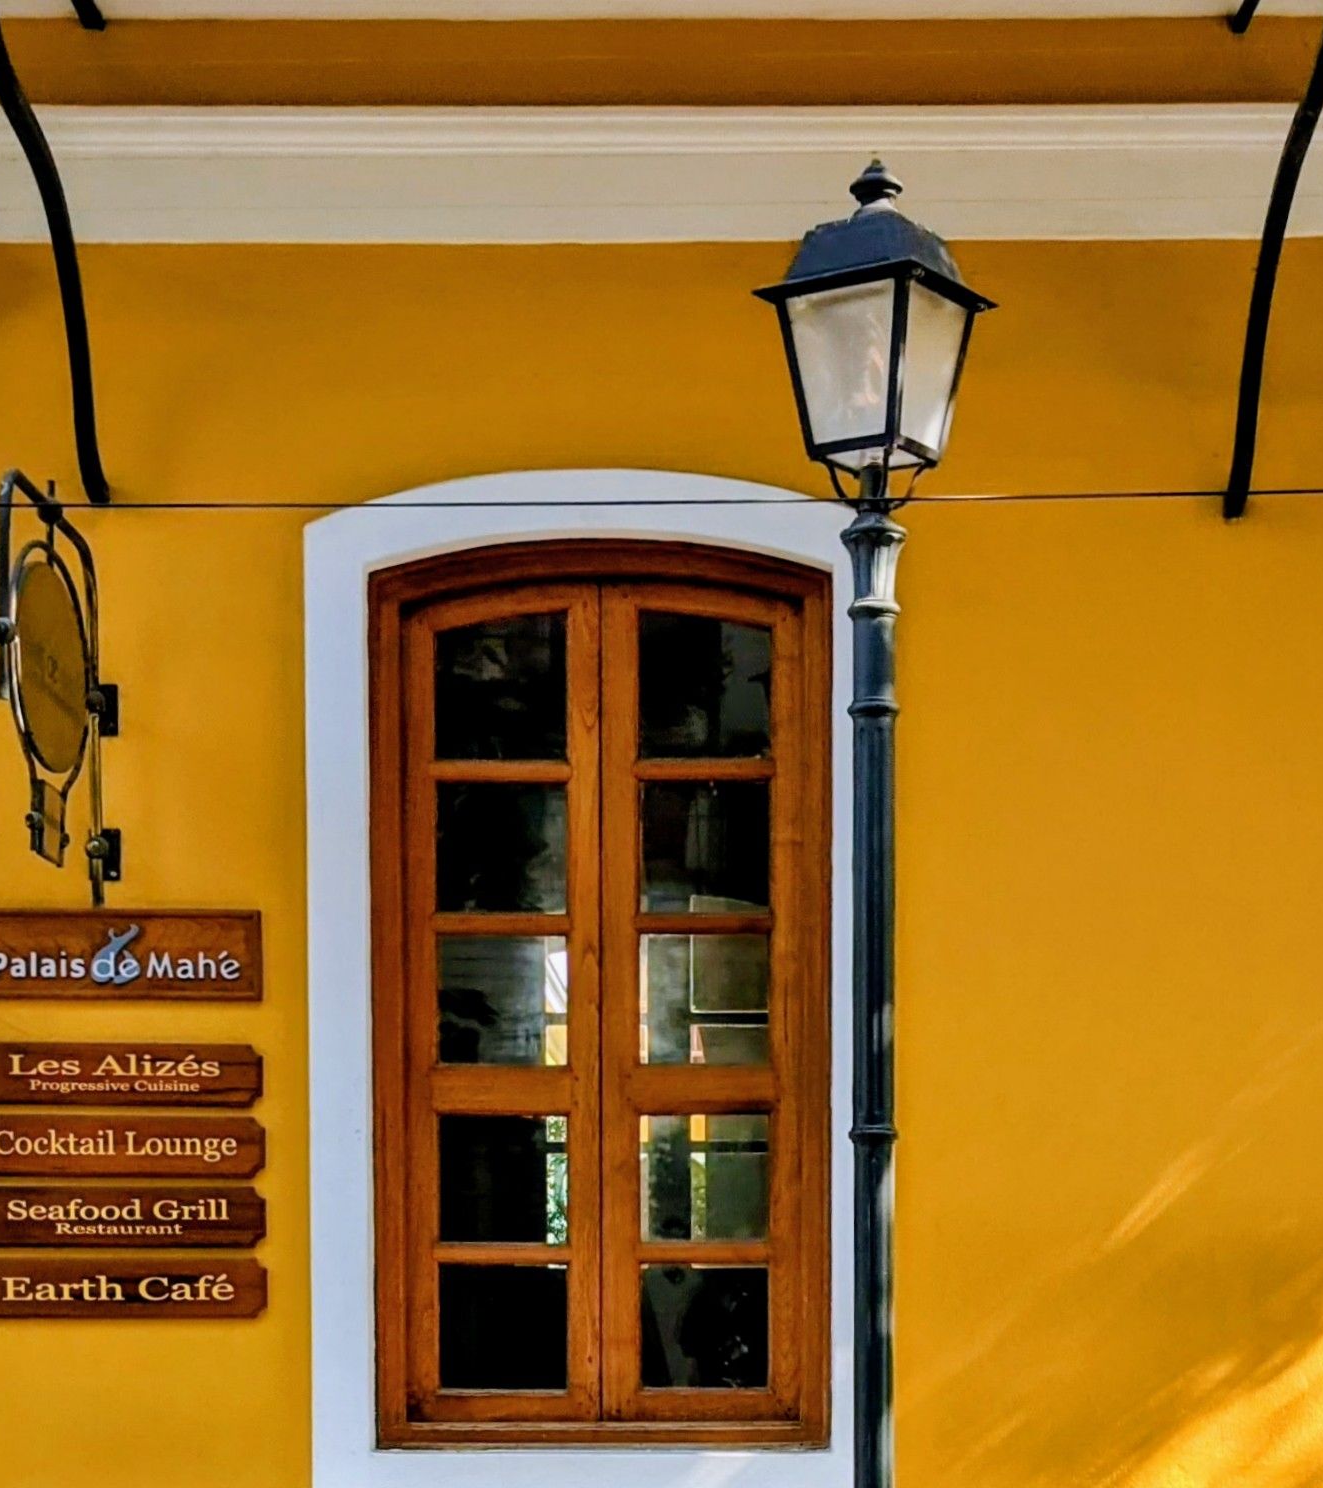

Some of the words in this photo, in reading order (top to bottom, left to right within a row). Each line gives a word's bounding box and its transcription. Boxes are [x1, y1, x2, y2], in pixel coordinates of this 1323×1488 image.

[91, 951, 140, 979] de
[146, 950, 241, 980] Mahé
[8, 1054, 80, 1076] Les
[92, 1053, 221, 1077] Alizés
[29, 1079, 131, 1093] Progressive
[134, 1079, 201, 1092] Cuisine
[125, 1131, 238, 1162] Lounge
[6, 1199, 143, 1221] Seafood
[152, 1199, 229, 1221] Grill
[55, 1223, 184, 1235] Restaurant
[1, 1275, 126, 1301] Earth
[138, 1273, 236, 1301] Café
